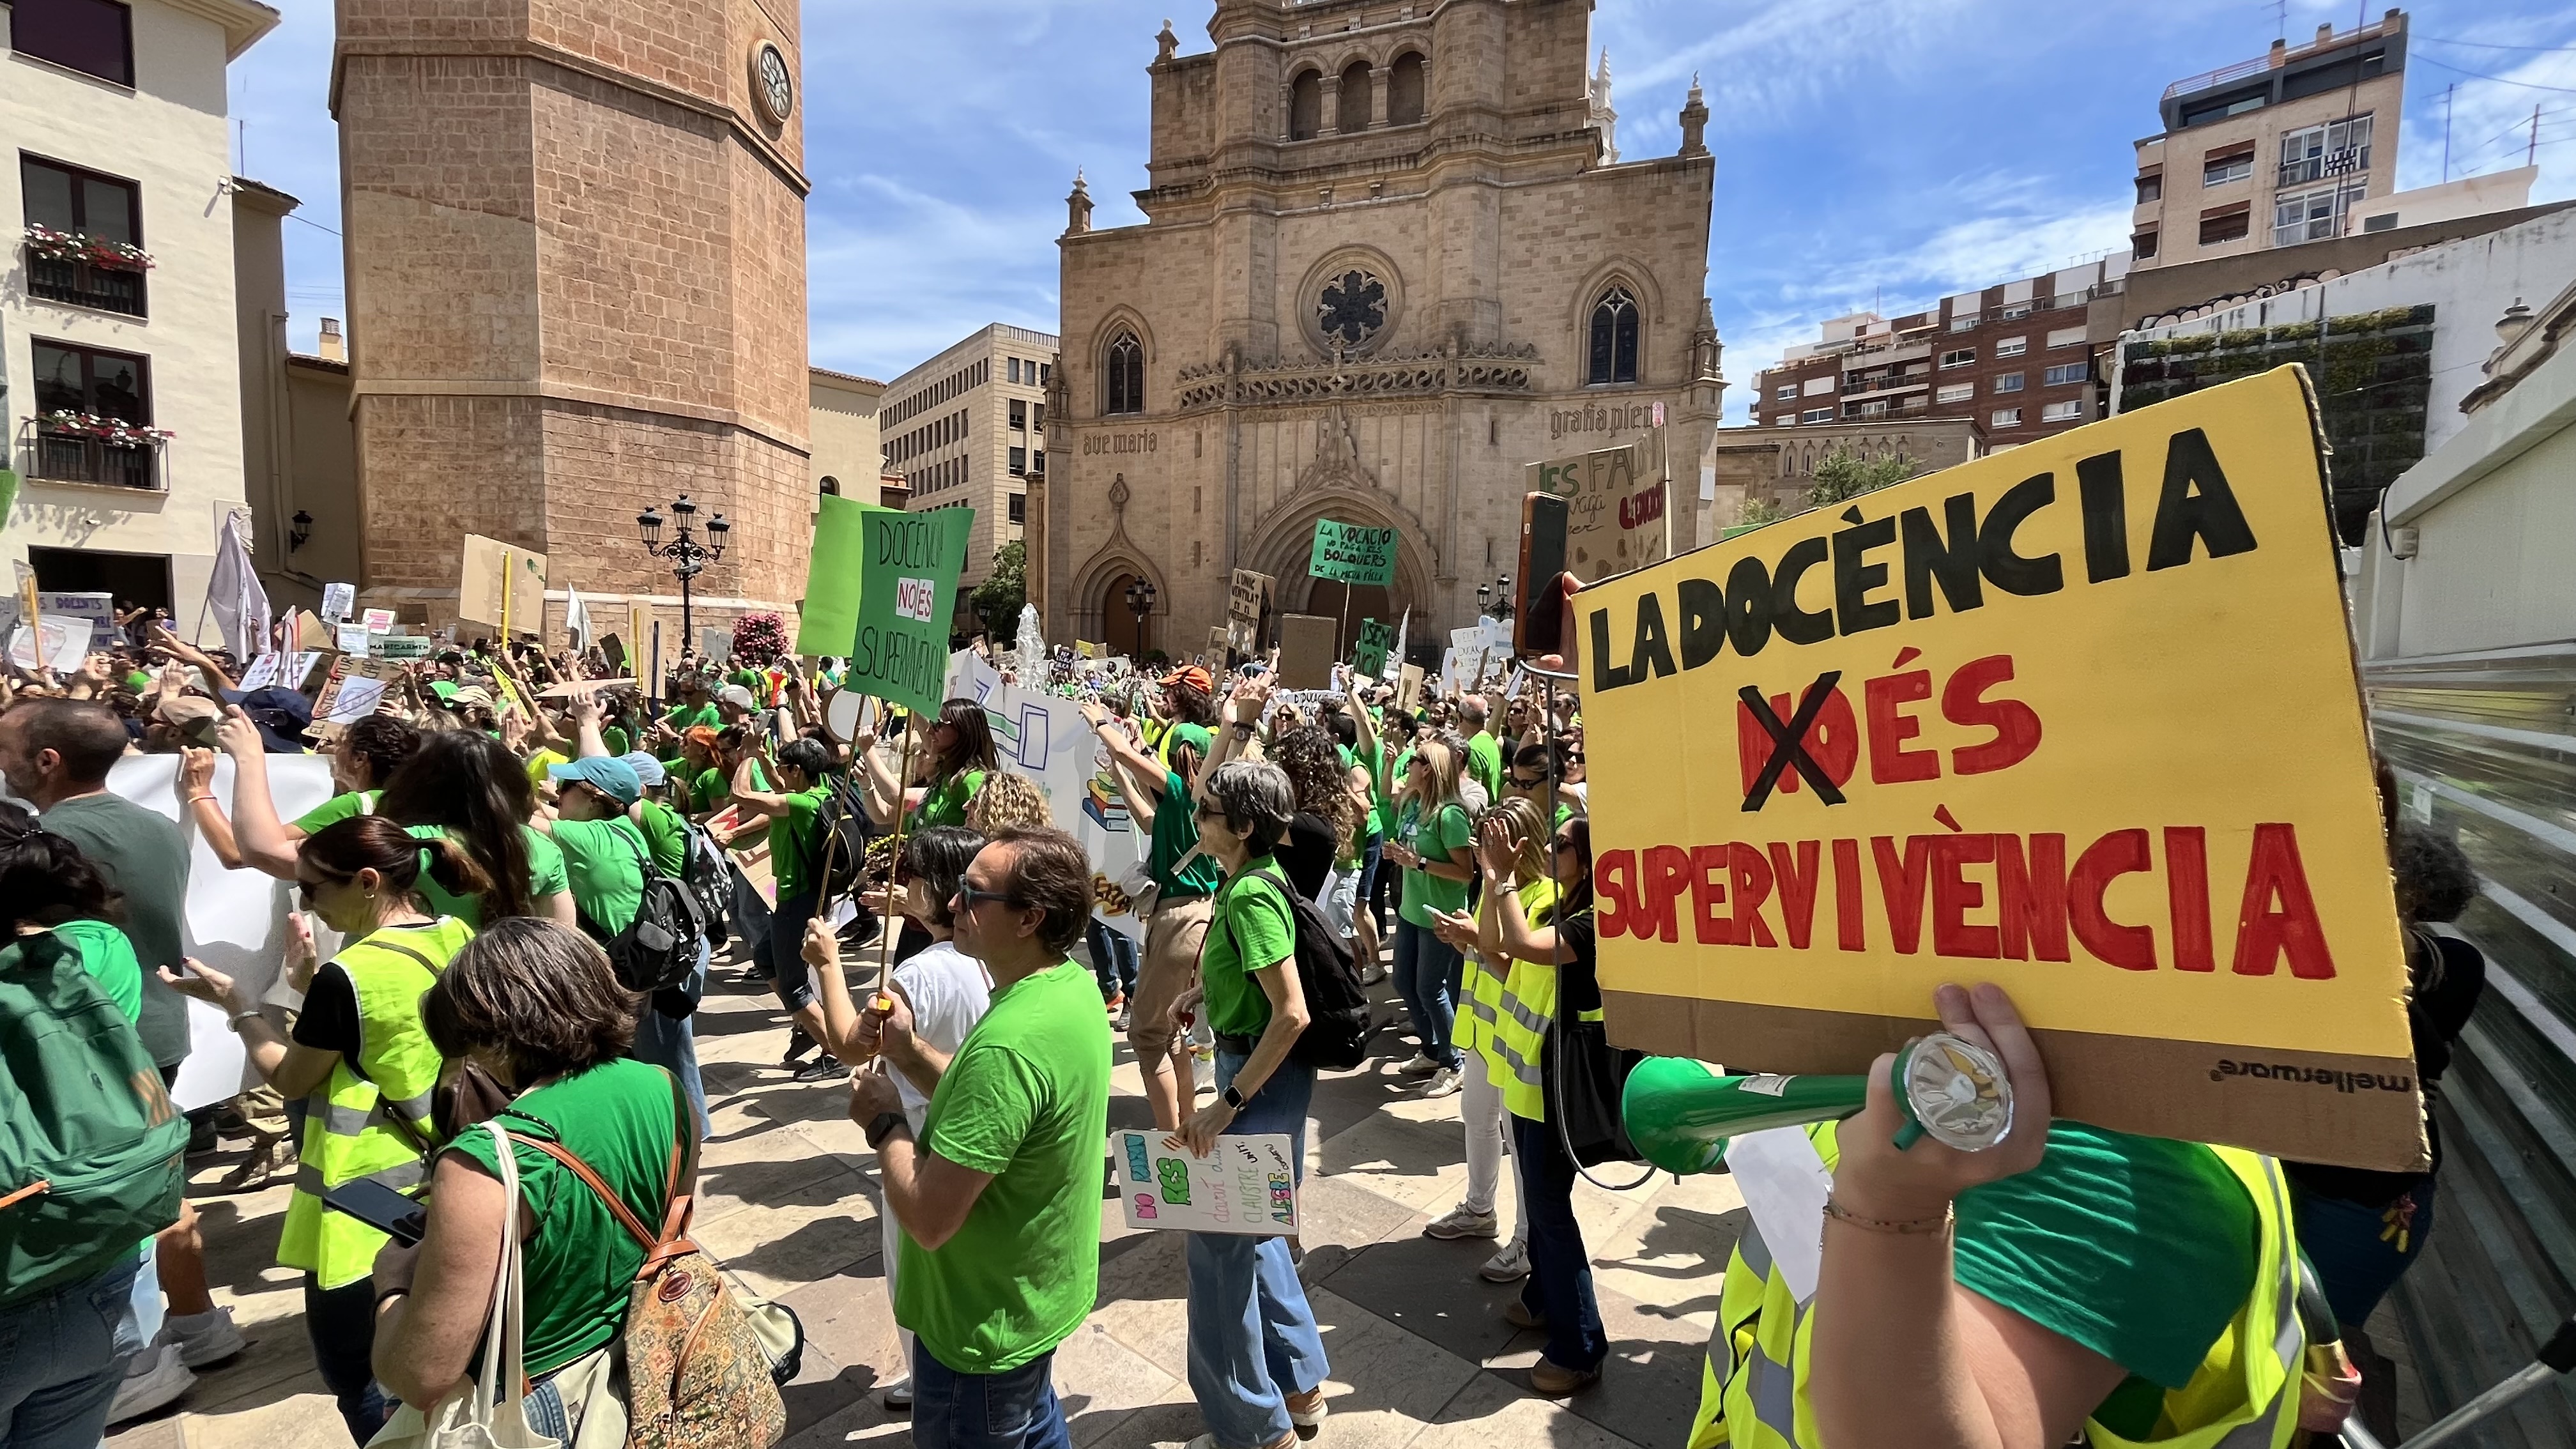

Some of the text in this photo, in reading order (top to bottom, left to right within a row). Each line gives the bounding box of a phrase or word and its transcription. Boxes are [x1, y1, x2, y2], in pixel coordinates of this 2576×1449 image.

[1083, 428, 1158, 456] ave maria
[1319, 523, 1333, 537] LA
[1324, 548, 1386, 567] BOLQUERS
[898, 582, 932, 618] NO ÉS
[309, 723, 325, 735] EL
[1593, 803, 2337, 980] SUPERVIVÈNCIA
[1156, 1156, 1192, 1206] RES
[1236, 1165, 1263, 1224] CLAUSTRE
[1133, 1192, 1158, 1219] NO
